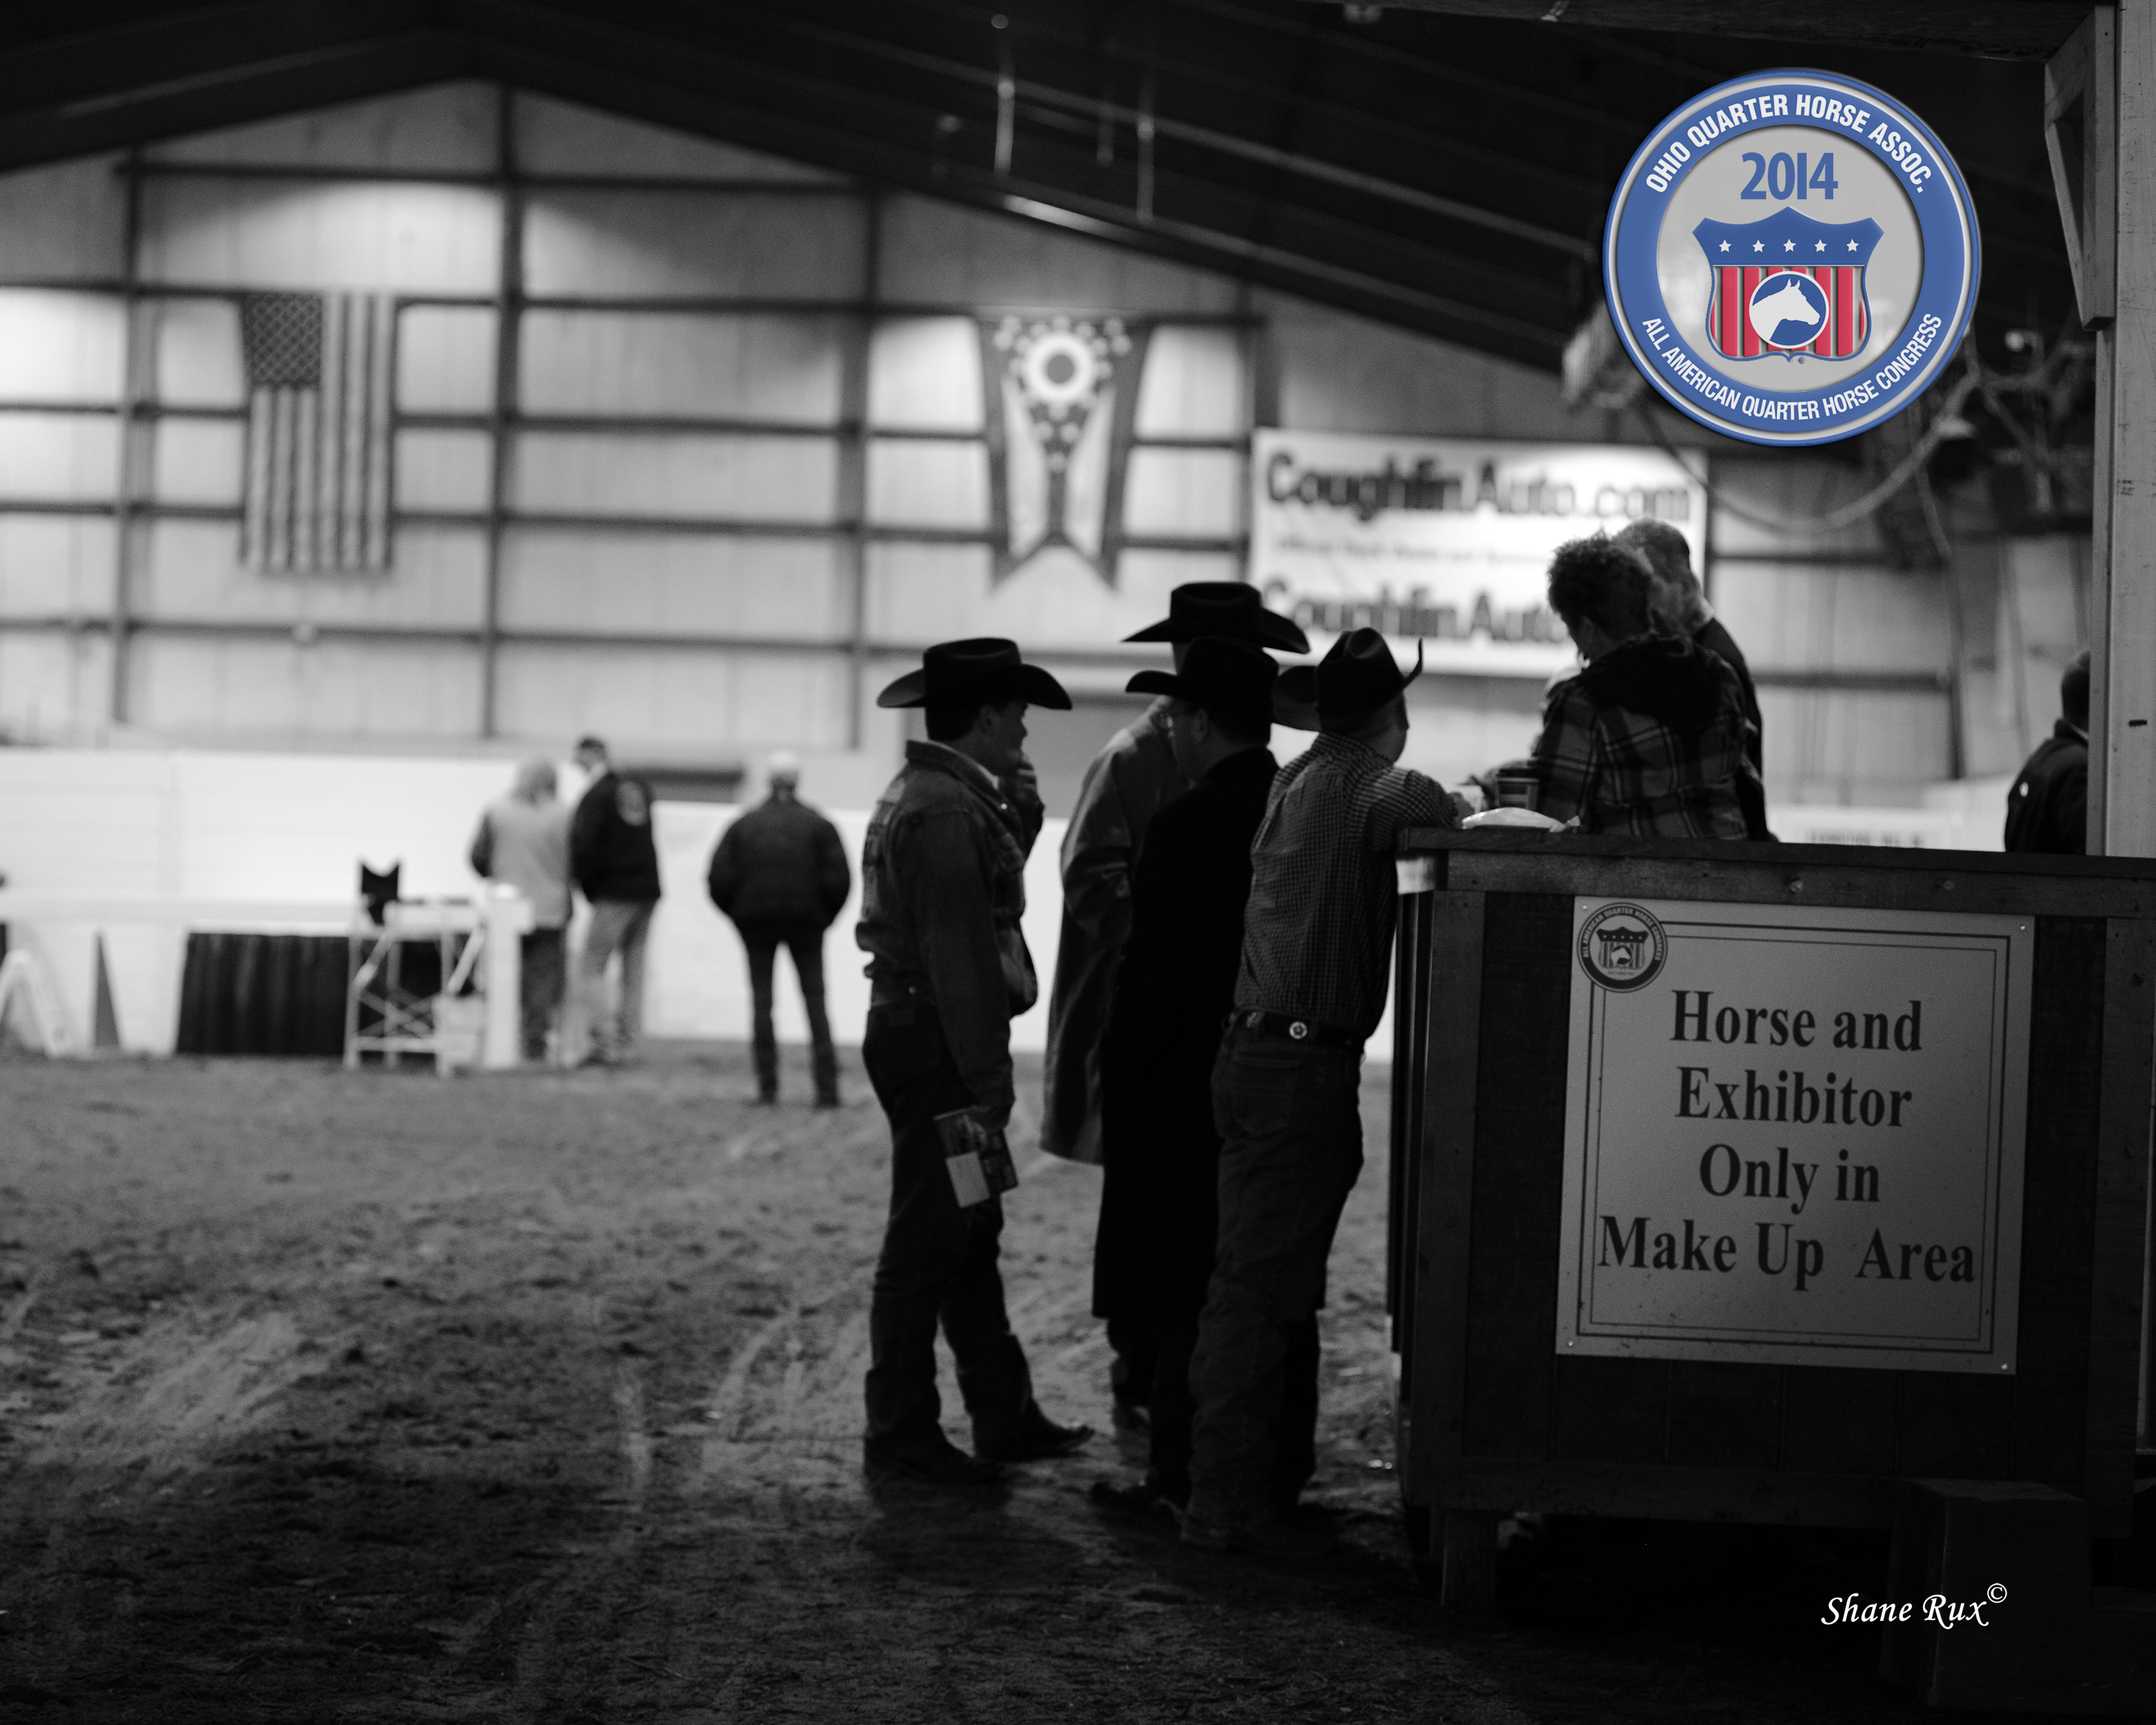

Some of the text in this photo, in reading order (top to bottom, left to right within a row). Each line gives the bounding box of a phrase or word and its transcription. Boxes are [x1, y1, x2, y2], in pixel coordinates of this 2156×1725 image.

[1669, 990, 1922, 1052] Horse and
[1674, 1066, 1912, 1127] Exhibitor
[1699, 1144, 1881, 1215] Only in
[1597, 1215, 1976, 1292] Make Up Area
